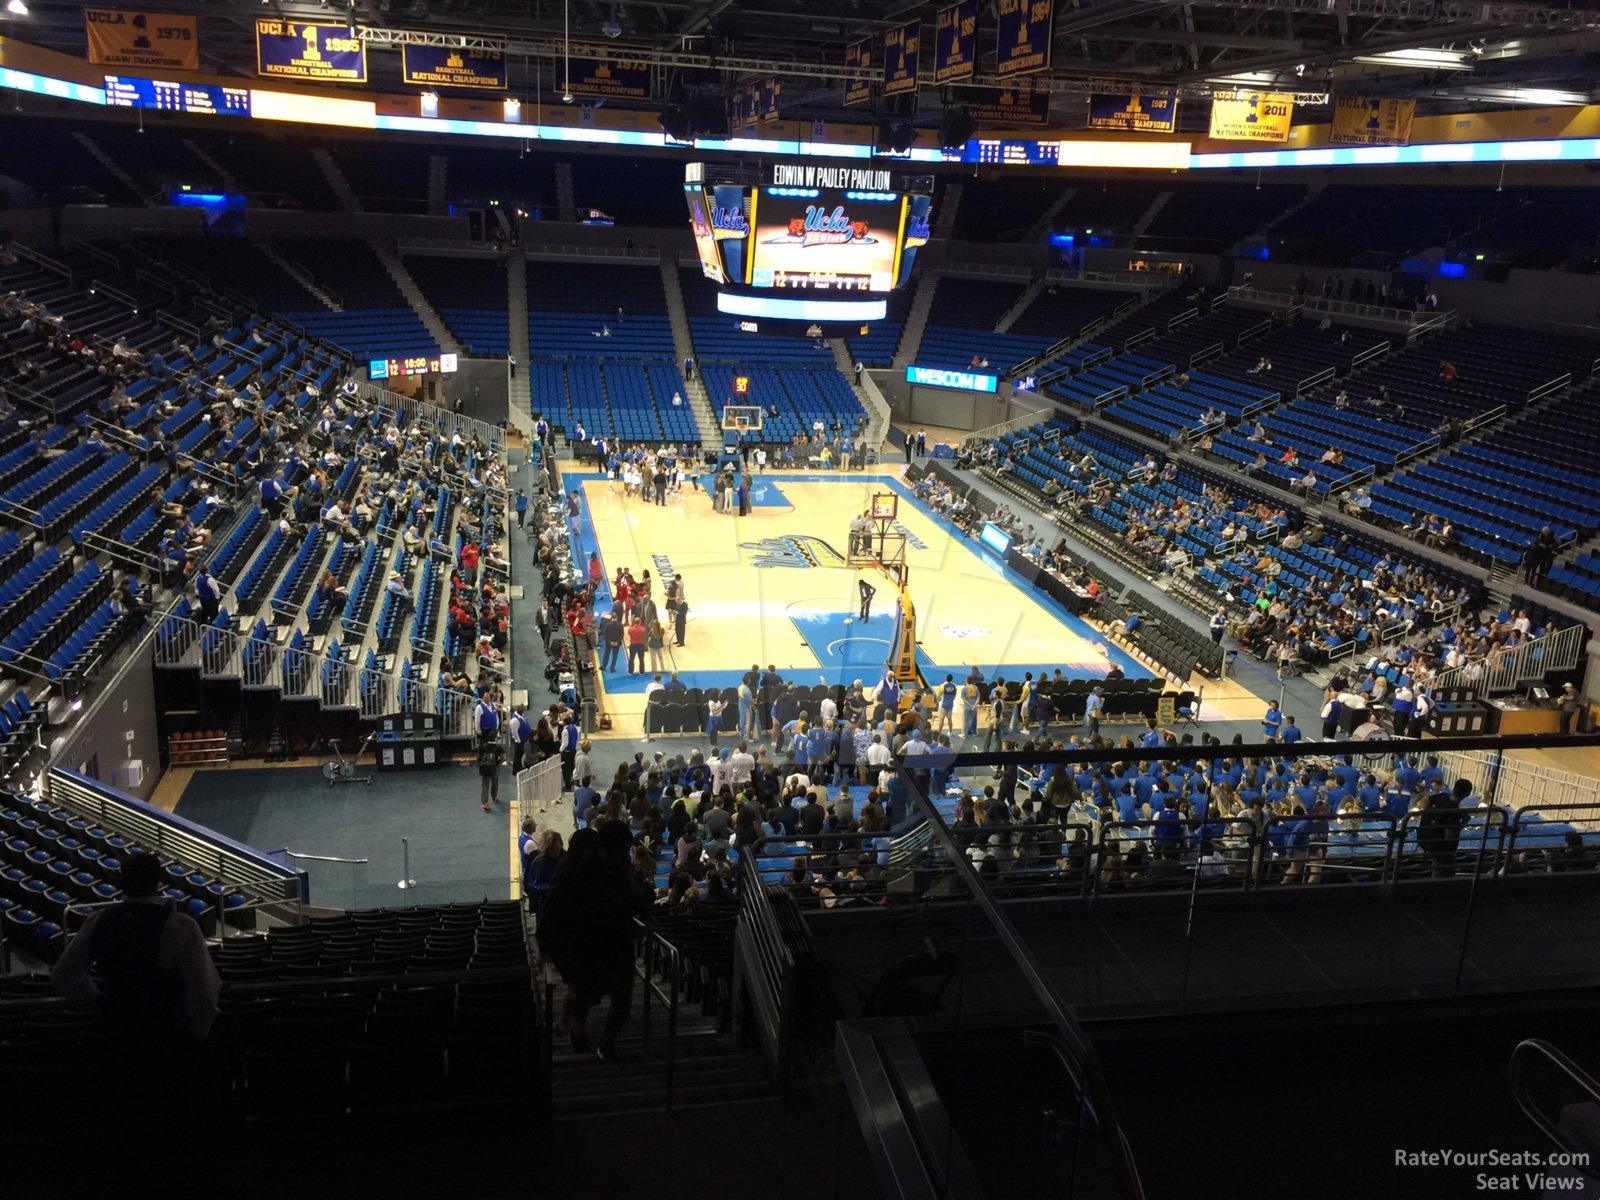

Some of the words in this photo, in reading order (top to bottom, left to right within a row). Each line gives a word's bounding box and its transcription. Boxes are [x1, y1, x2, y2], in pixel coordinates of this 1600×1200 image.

[87, 12, 126, 25] UCLA
[157, 27, 192, 40] 1978
[291, 59, 333, 68] BASKETBALL
[267, 64, 308, 75] NATIONAL
[310, 68, 358, 78] CHAMPIONS
[435, 66, 475, 75] BASKETBALL
[412, 71, 451, 82] NATIONAL
[452, 75, 499, 85] CHAMPIONS
[1337, 96, 1369, 109] UCLA
[1264, 104, 1287, 116] 2011
[1092, 117, 1127, 126] NATIONAL
[1113, 112, 1150, 121] GYMNASTICS
[1248, 131, 1284, 139] CHAMPIONS
[1333, 134, 1363, 142] NATIONAL
[773, 164, 804, 186] EDWIN
[806, 166, 816, 187] W
[816, 167, 850, 188] PAULEY
[851, 168, 891, 190] PAVILION
[805, 205, 854, 241] Ucla
[404, 357, 427, 369] 10:00
[431, 360, 440, 372] 12
[389, 364, 399, 376] 12
[915, 367, 976, 389] WESCOM
[719, 770, 726, 780] 3
